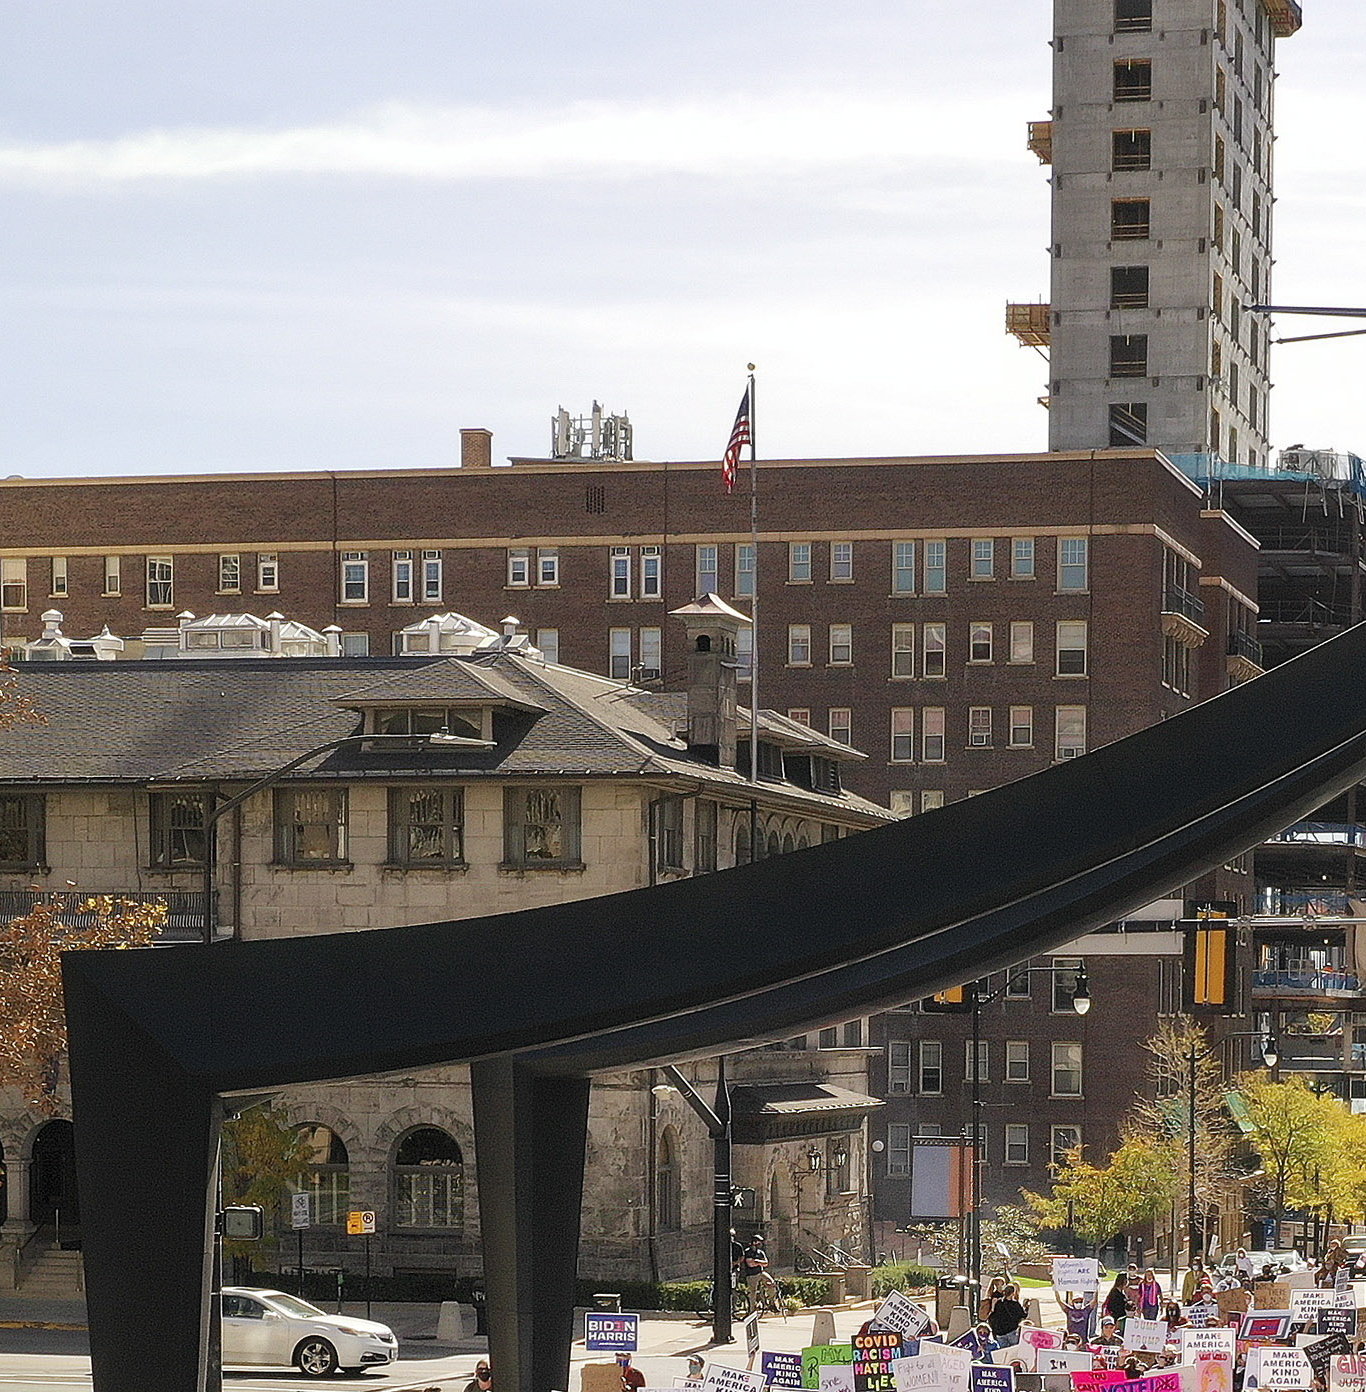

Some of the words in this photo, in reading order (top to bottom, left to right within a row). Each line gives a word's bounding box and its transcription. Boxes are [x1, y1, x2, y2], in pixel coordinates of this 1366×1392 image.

[589, 1321, 635, 1331] BIDEN
[589, 1332, 635, 1341] HARRIS
[855, 1335, 897, 1347] COVID
[853, 1348, 900, 1360] RACISM
[1040, 1376, 1045, 1391] I
